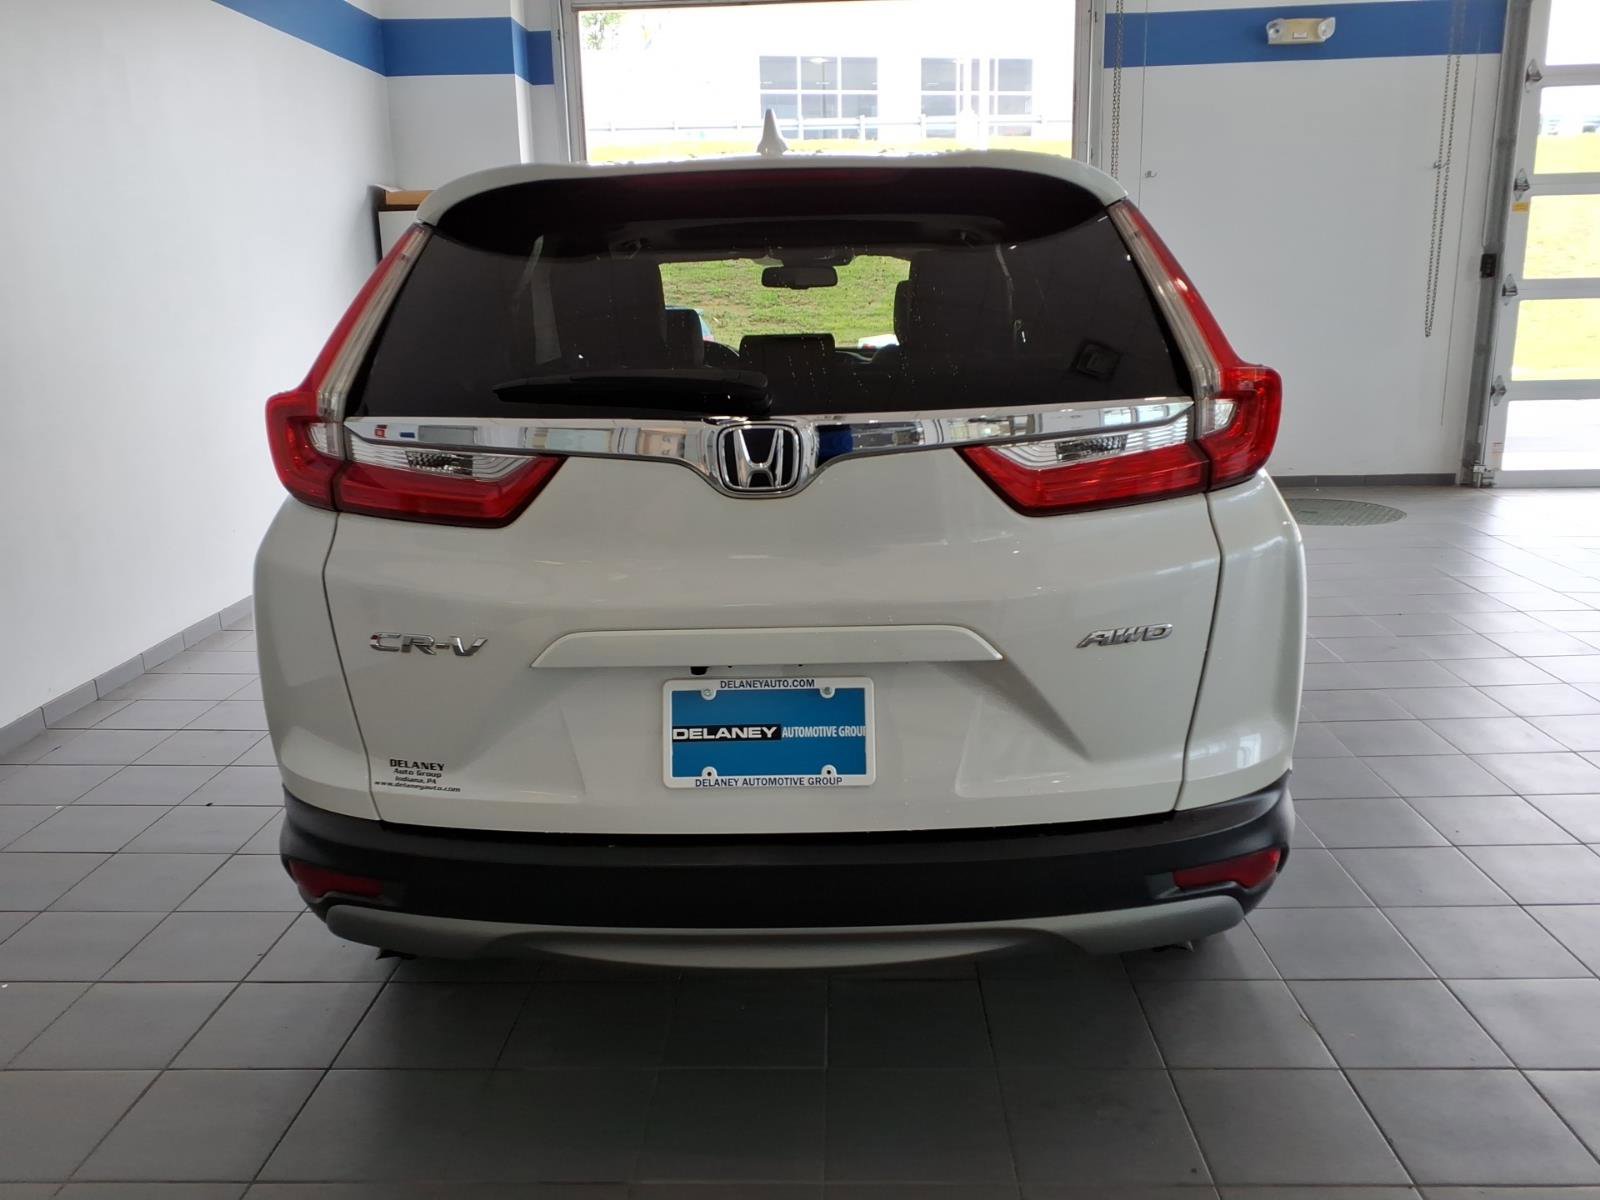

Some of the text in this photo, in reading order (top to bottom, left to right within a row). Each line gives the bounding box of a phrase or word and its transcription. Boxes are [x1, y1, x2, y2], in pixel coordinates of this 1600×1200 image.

[1076, 623, 1173, 649] AWD
[369, 632, 488, 656] CR-V
[720, 679, 815, 689] DELANEYAUTO.COM
[672, 726, 777, 740] DELANEY
[781, 726, 837, 738] AUTOMOTIVE
[390, 759, 445, 771] DELANEY
[416, 770, 442, 778] Group
[695, 776, 843, 787] DELANEY AUTOMOTIVE GROUP
